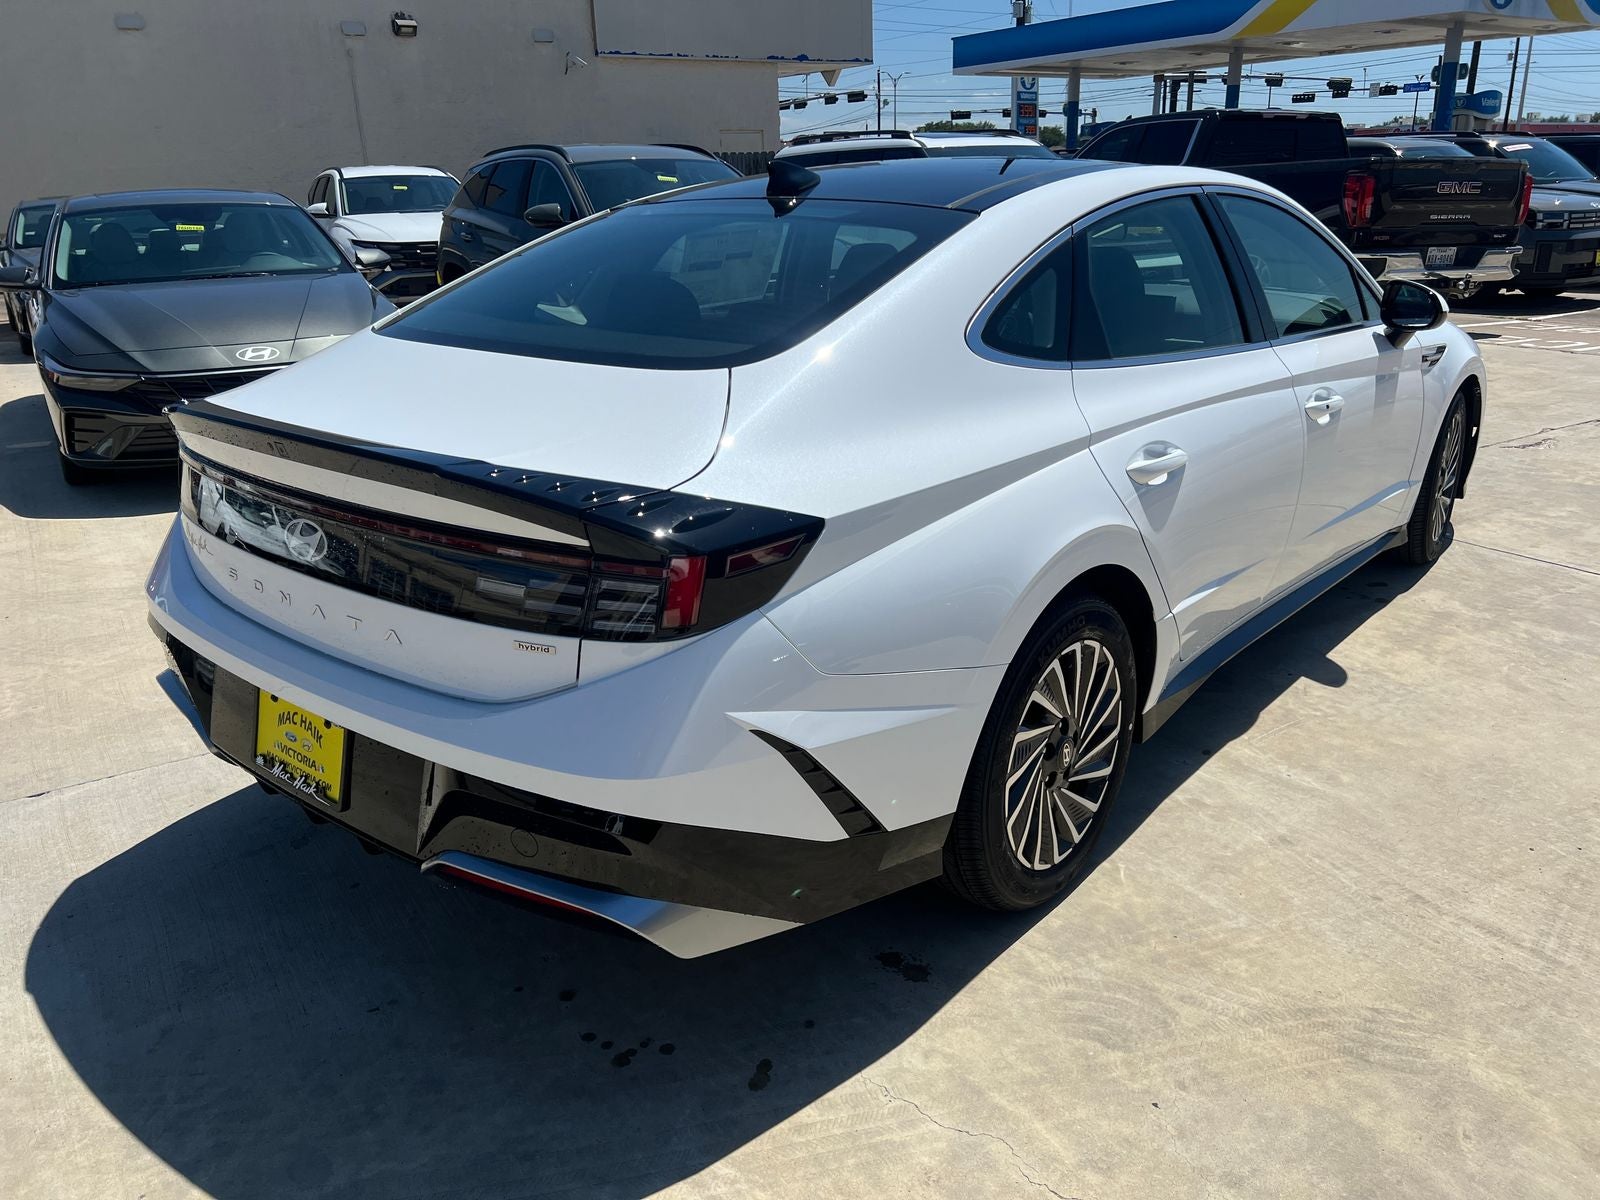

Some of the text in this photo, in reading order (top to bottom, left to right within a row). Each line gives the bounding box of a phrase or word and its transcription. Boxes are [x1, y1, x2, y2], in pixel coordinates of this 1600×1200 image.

[1437, 181, 1482, 194] GMC
[228, 567, 403, 646] SONATA
[518, 642, 550, 653] hybrid
[277, 711, 299, 727] MAC
[300, 714, 324, 749] HAIK
[280, 742, 317, 771] VICTORIA
[270, 762, 292, 785] Mac
